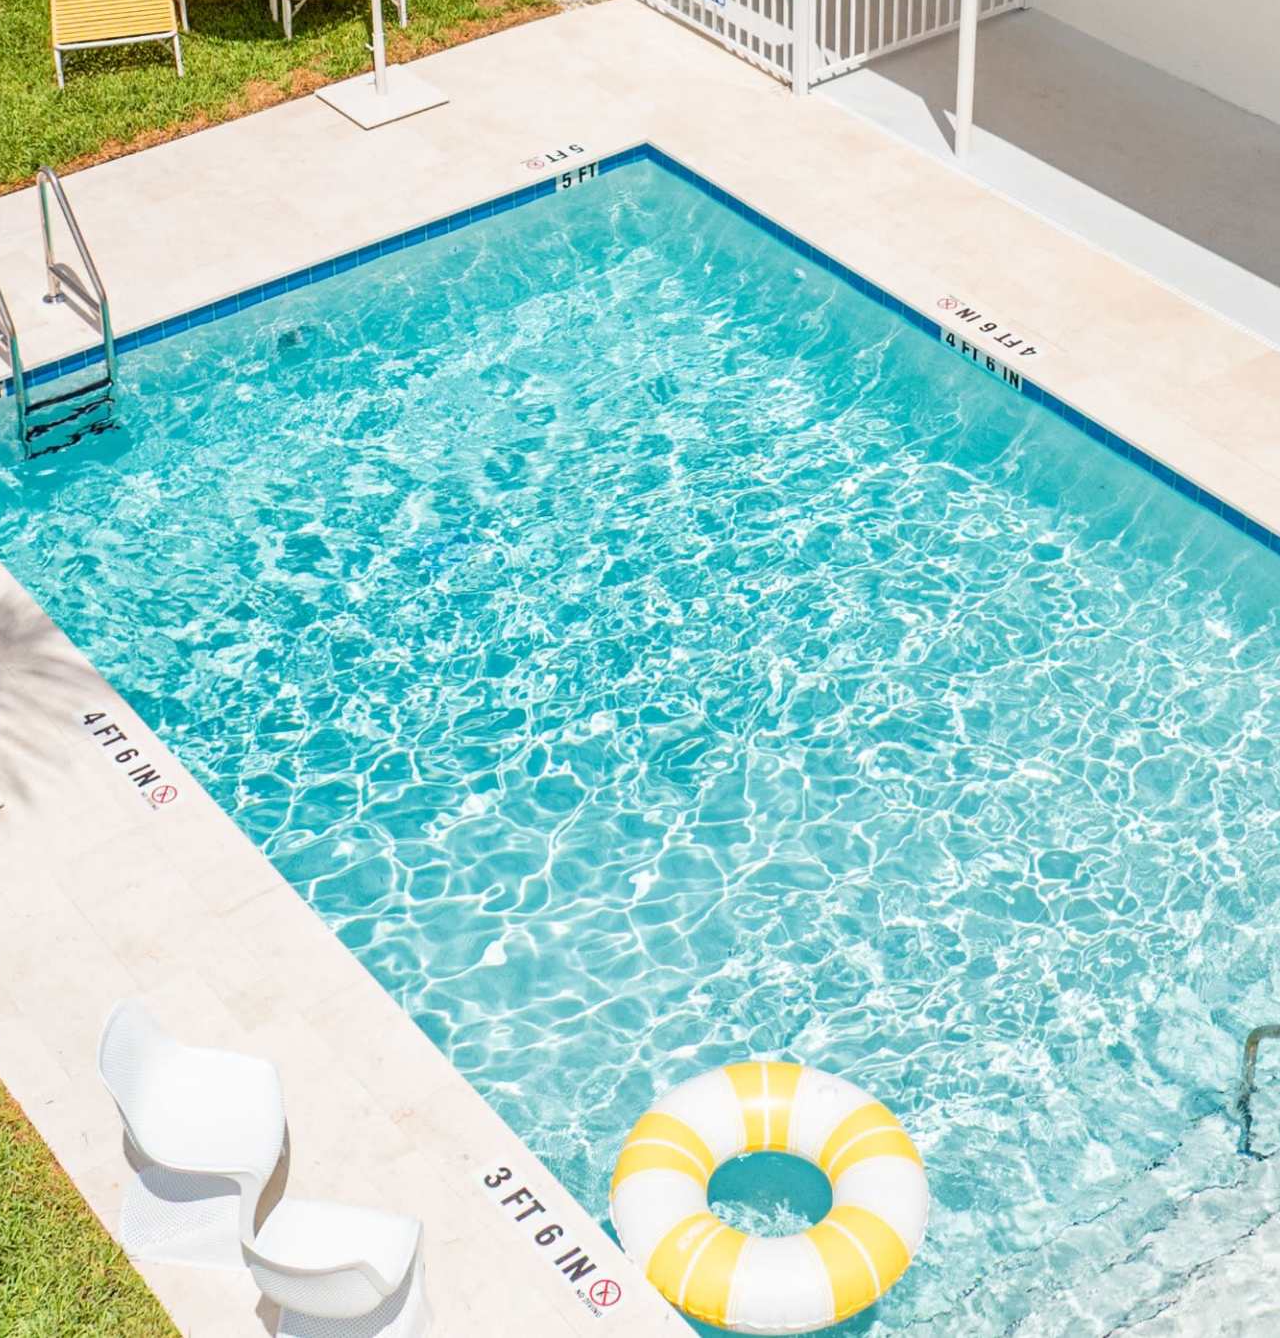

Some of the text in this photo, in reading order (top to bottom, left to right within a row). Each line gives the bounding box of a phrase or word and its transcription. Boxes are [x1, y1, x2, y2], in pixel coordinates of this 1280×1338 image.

[545, 150, 568, 163] FT
[569, 144, 584, 154] 5
[562, 162, 597, 189] 5 FT
[955, 308, 982, 322] IN
[993, 333, 1023, 348] FT
[1019, 347, 1037, 356] 4
[946, 332, 1019, 389] 4 FT 6 IN
[84, 713, 106, 725] 4
[93, 723, 128, 746] FT
[115, 748, 139, 763] 6
[128, 764, 161, 787] IN
[483, 1167, 597, 1283] 3 FT 6 IN
